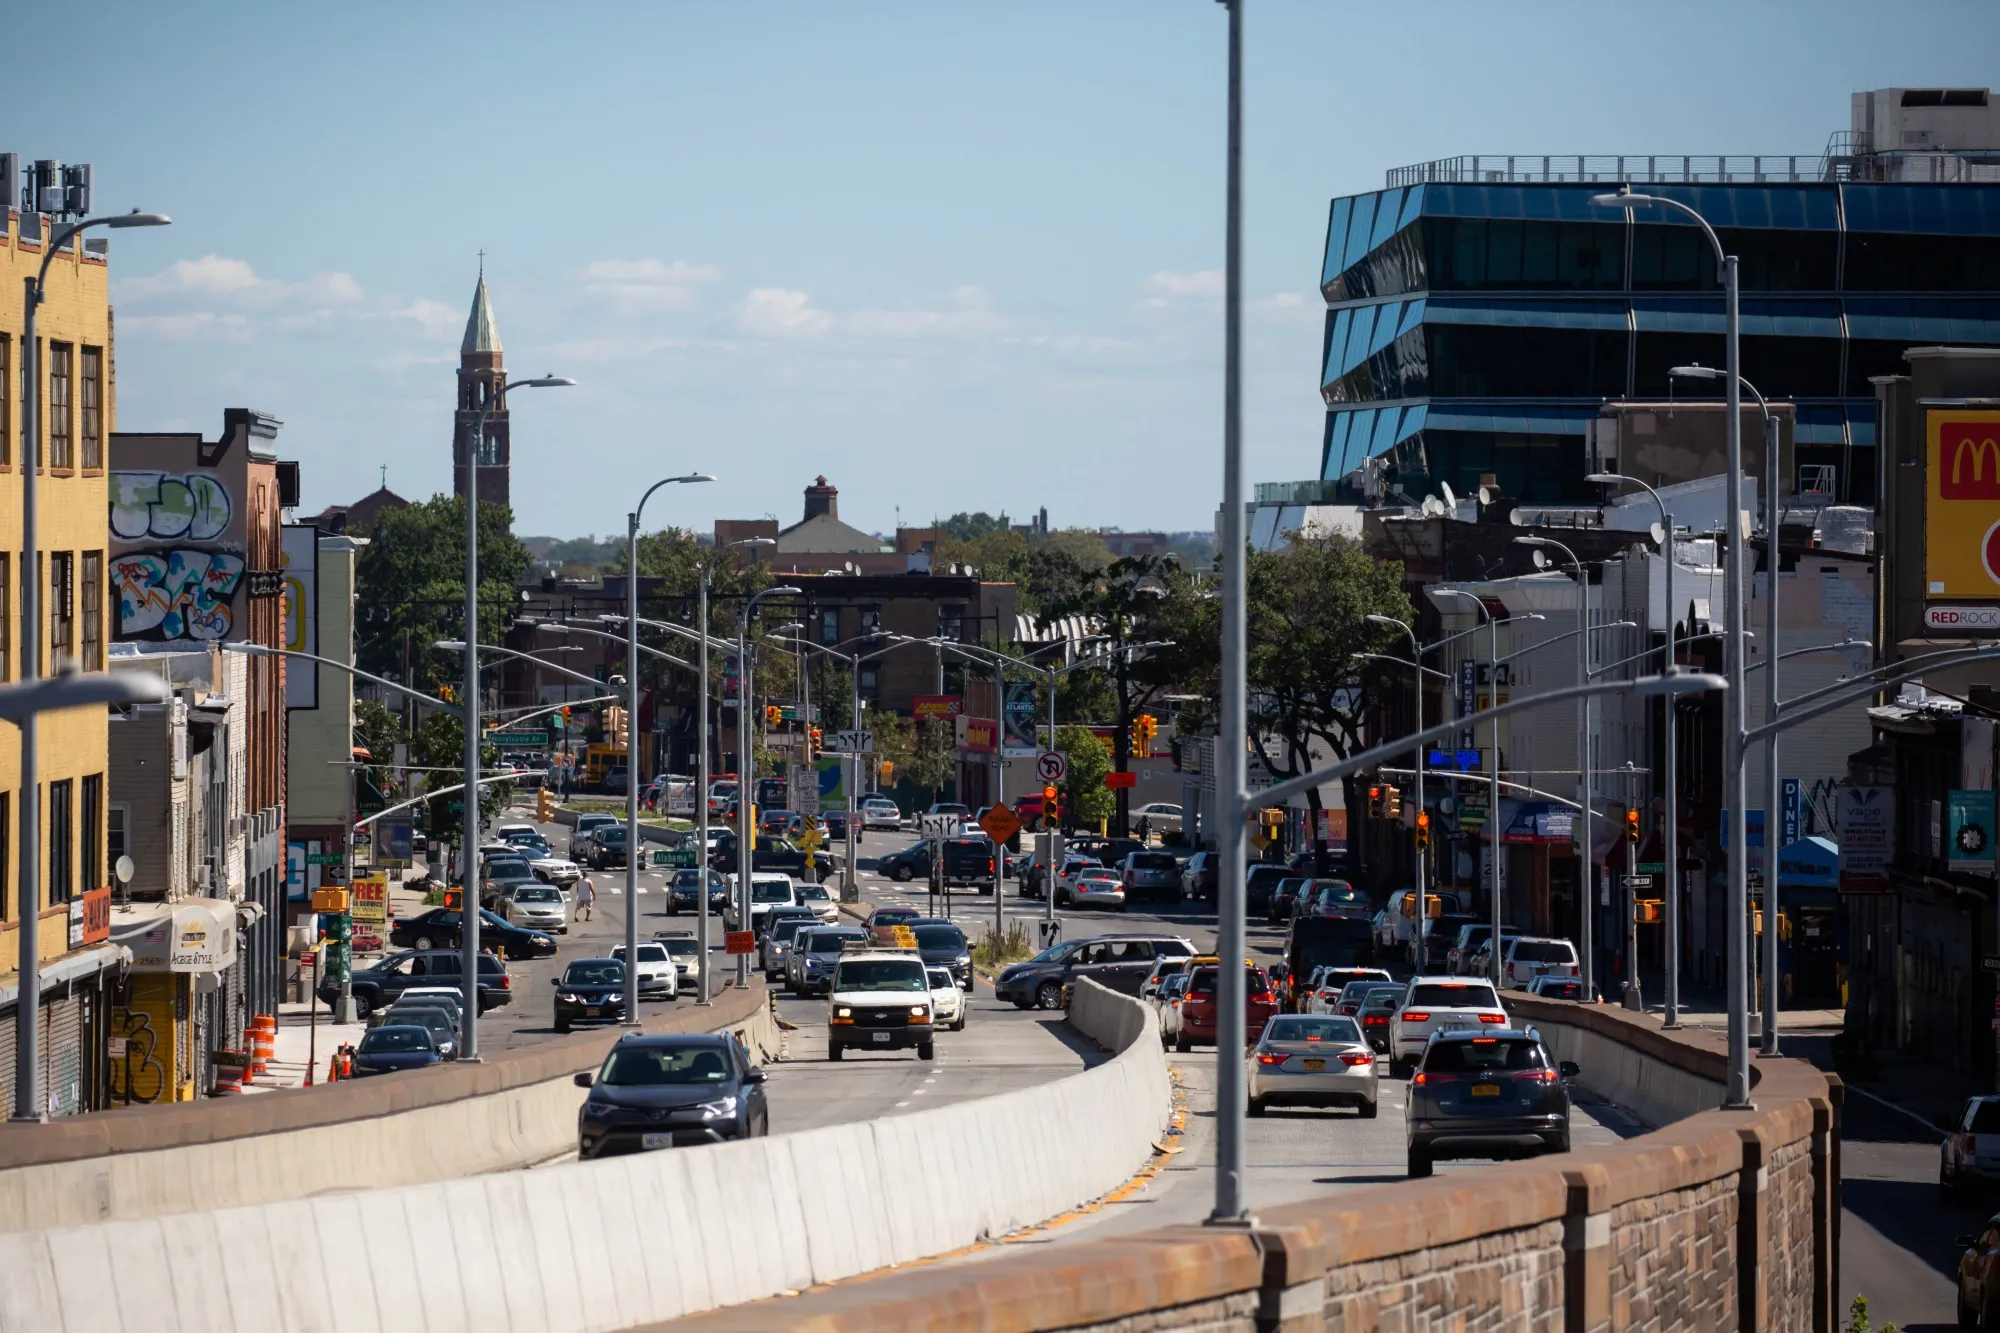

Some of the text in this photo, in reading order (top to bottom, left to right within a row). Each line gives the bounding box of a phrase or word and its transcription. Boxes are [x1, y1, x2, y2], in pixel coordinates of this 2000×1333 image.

[1931, 612, 1998, 624] REDROCK
[1464, 662, 1473, 685] MAIN
[1464, 689, 1473, 734] ENTRAE
[1847, 808, 1881, 822] vape
[307, 855, 333, 864] Georgia
[655, 853, 688, 863] Alabama
[728, 934, 753, 942] RAISE
[728, 942, 753, 950] PLOW
[140, 957, 161, 965] 2565
[193, 951, 213, 965] STYLE
